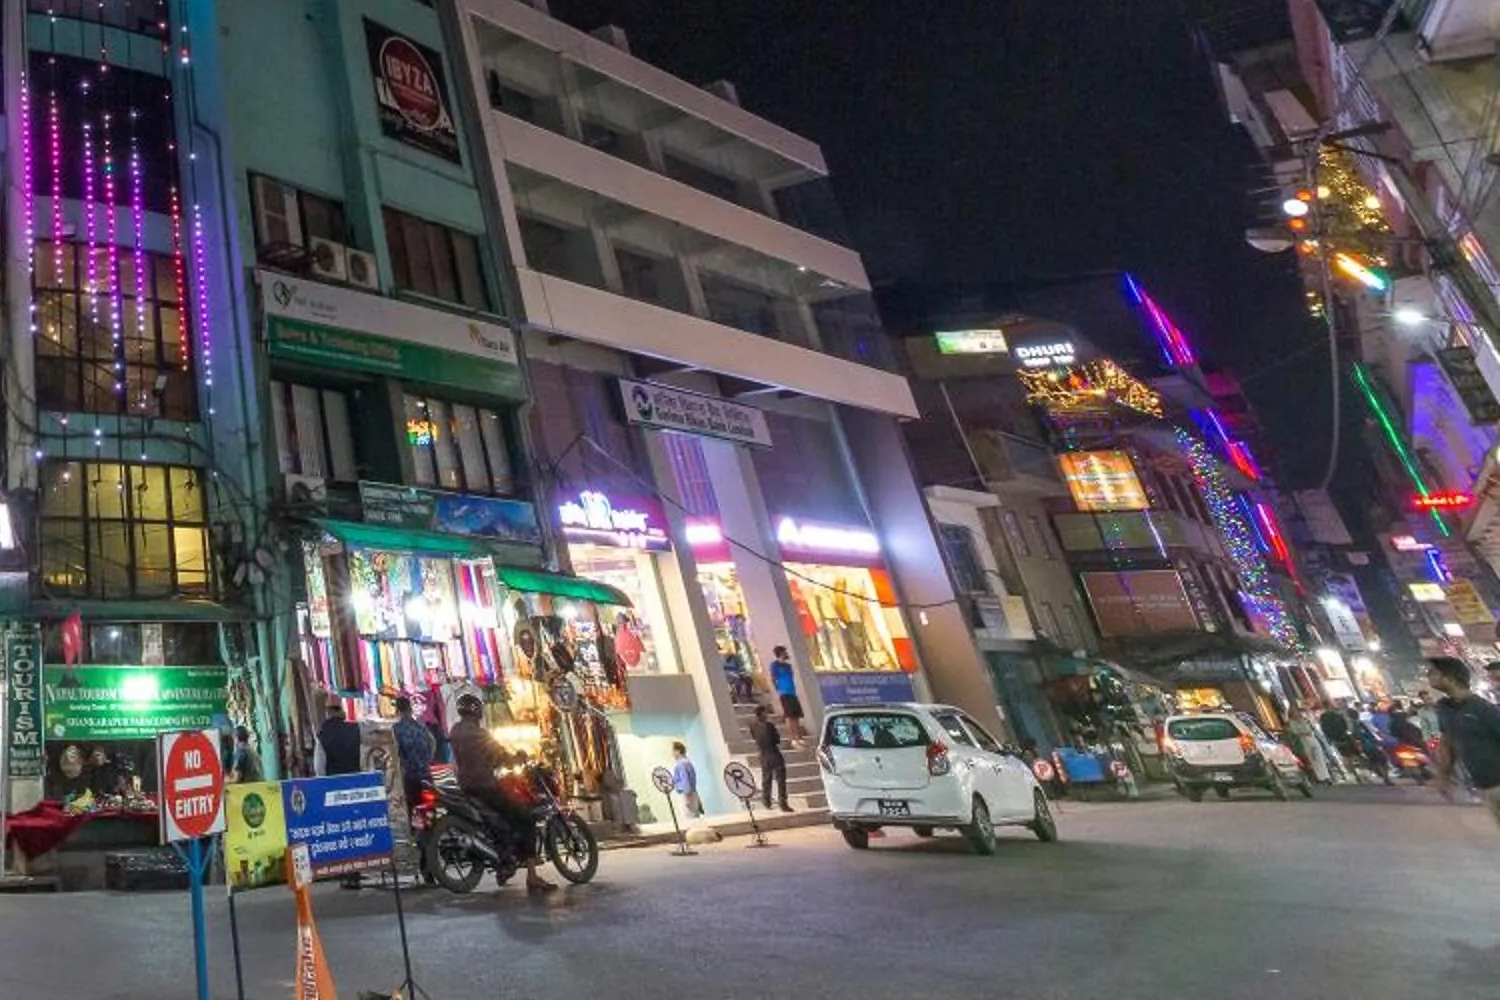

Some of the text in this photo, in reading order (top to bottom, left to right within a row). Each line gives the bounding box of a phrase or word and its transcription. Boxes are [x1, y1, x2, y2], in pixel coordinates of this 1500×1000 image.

[13, 645, 39, 745] TOURISM
[184, 748, 201, 769] NO
[176, 793, 215, 819] ENTRY
